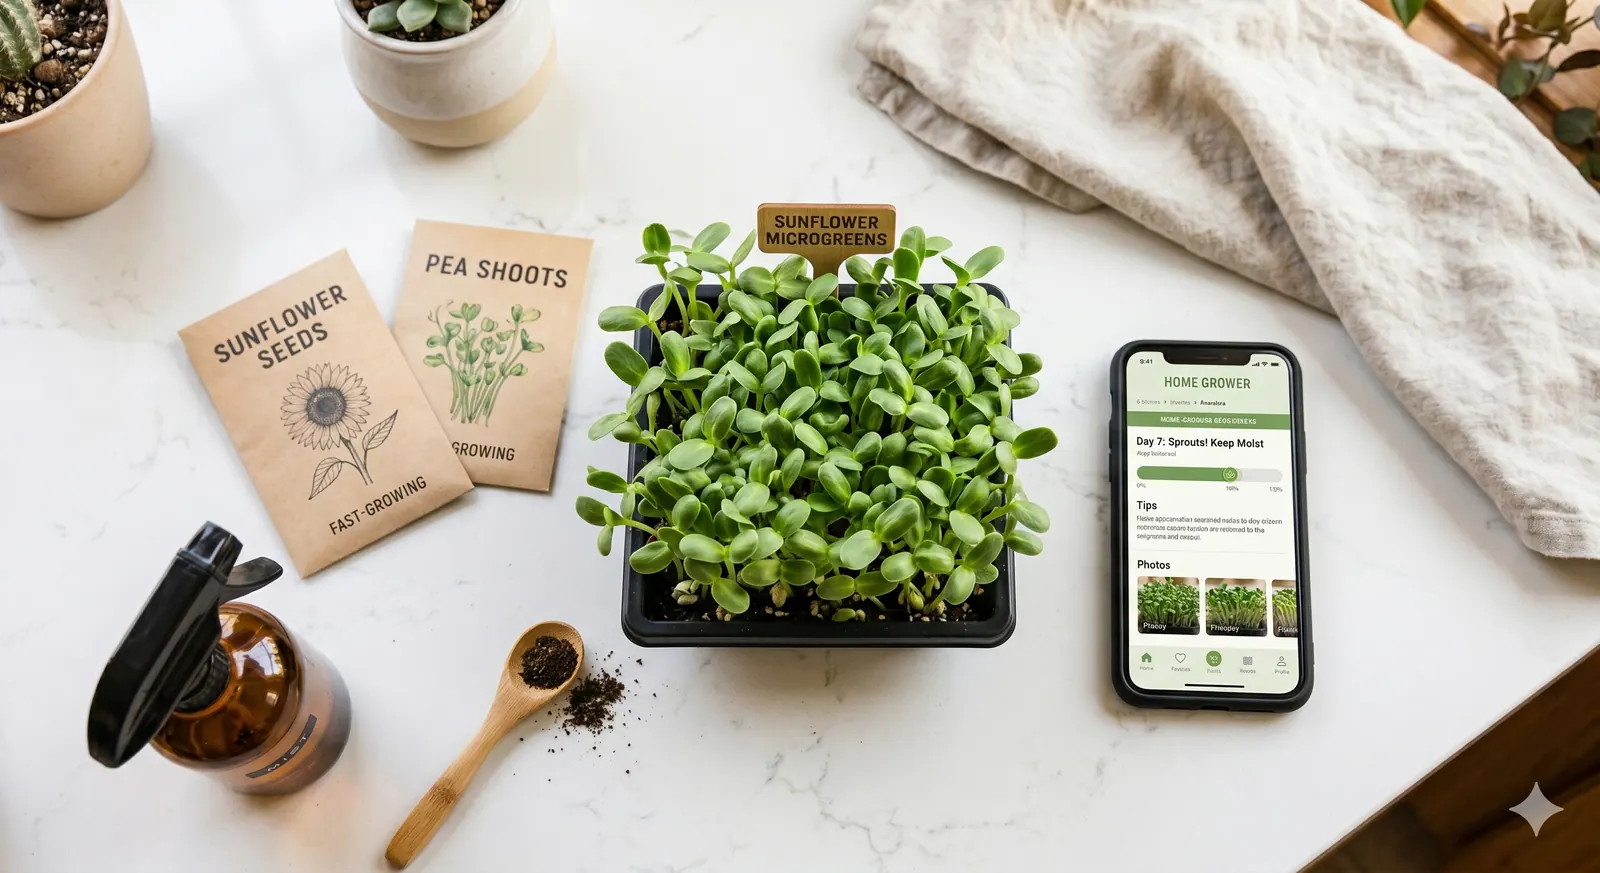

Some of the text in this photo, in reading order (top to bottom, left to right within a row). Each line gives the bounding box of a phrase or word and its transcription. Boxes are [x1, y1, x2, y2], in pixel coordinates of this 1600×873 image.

[774, 215, 879, 229] SUNFLOWER
[766, 232, 887, 246] MICROGREENS
[425, 254, 568, 288] PEA SHOOTS
[214, 284, 347, 363] SUNFLOWER
[257, 322, 328, 370] SEEDS
[1164, 376, 1251, 389] HOME GROWER
[1136, 437, 1154, 447] Day
[1157, 437, 1165, 446] 7:
[1168, 437, 1208, 448] Sprouts!
[1211, 438, 1234, 449] Keep
[451, 441, 515, 461] GROWING
[329, 476, 427, 535] FAST-GROWING
[1137, 501, 1157, 511] Tips
[1137, 560, 1171, 570] Photos
